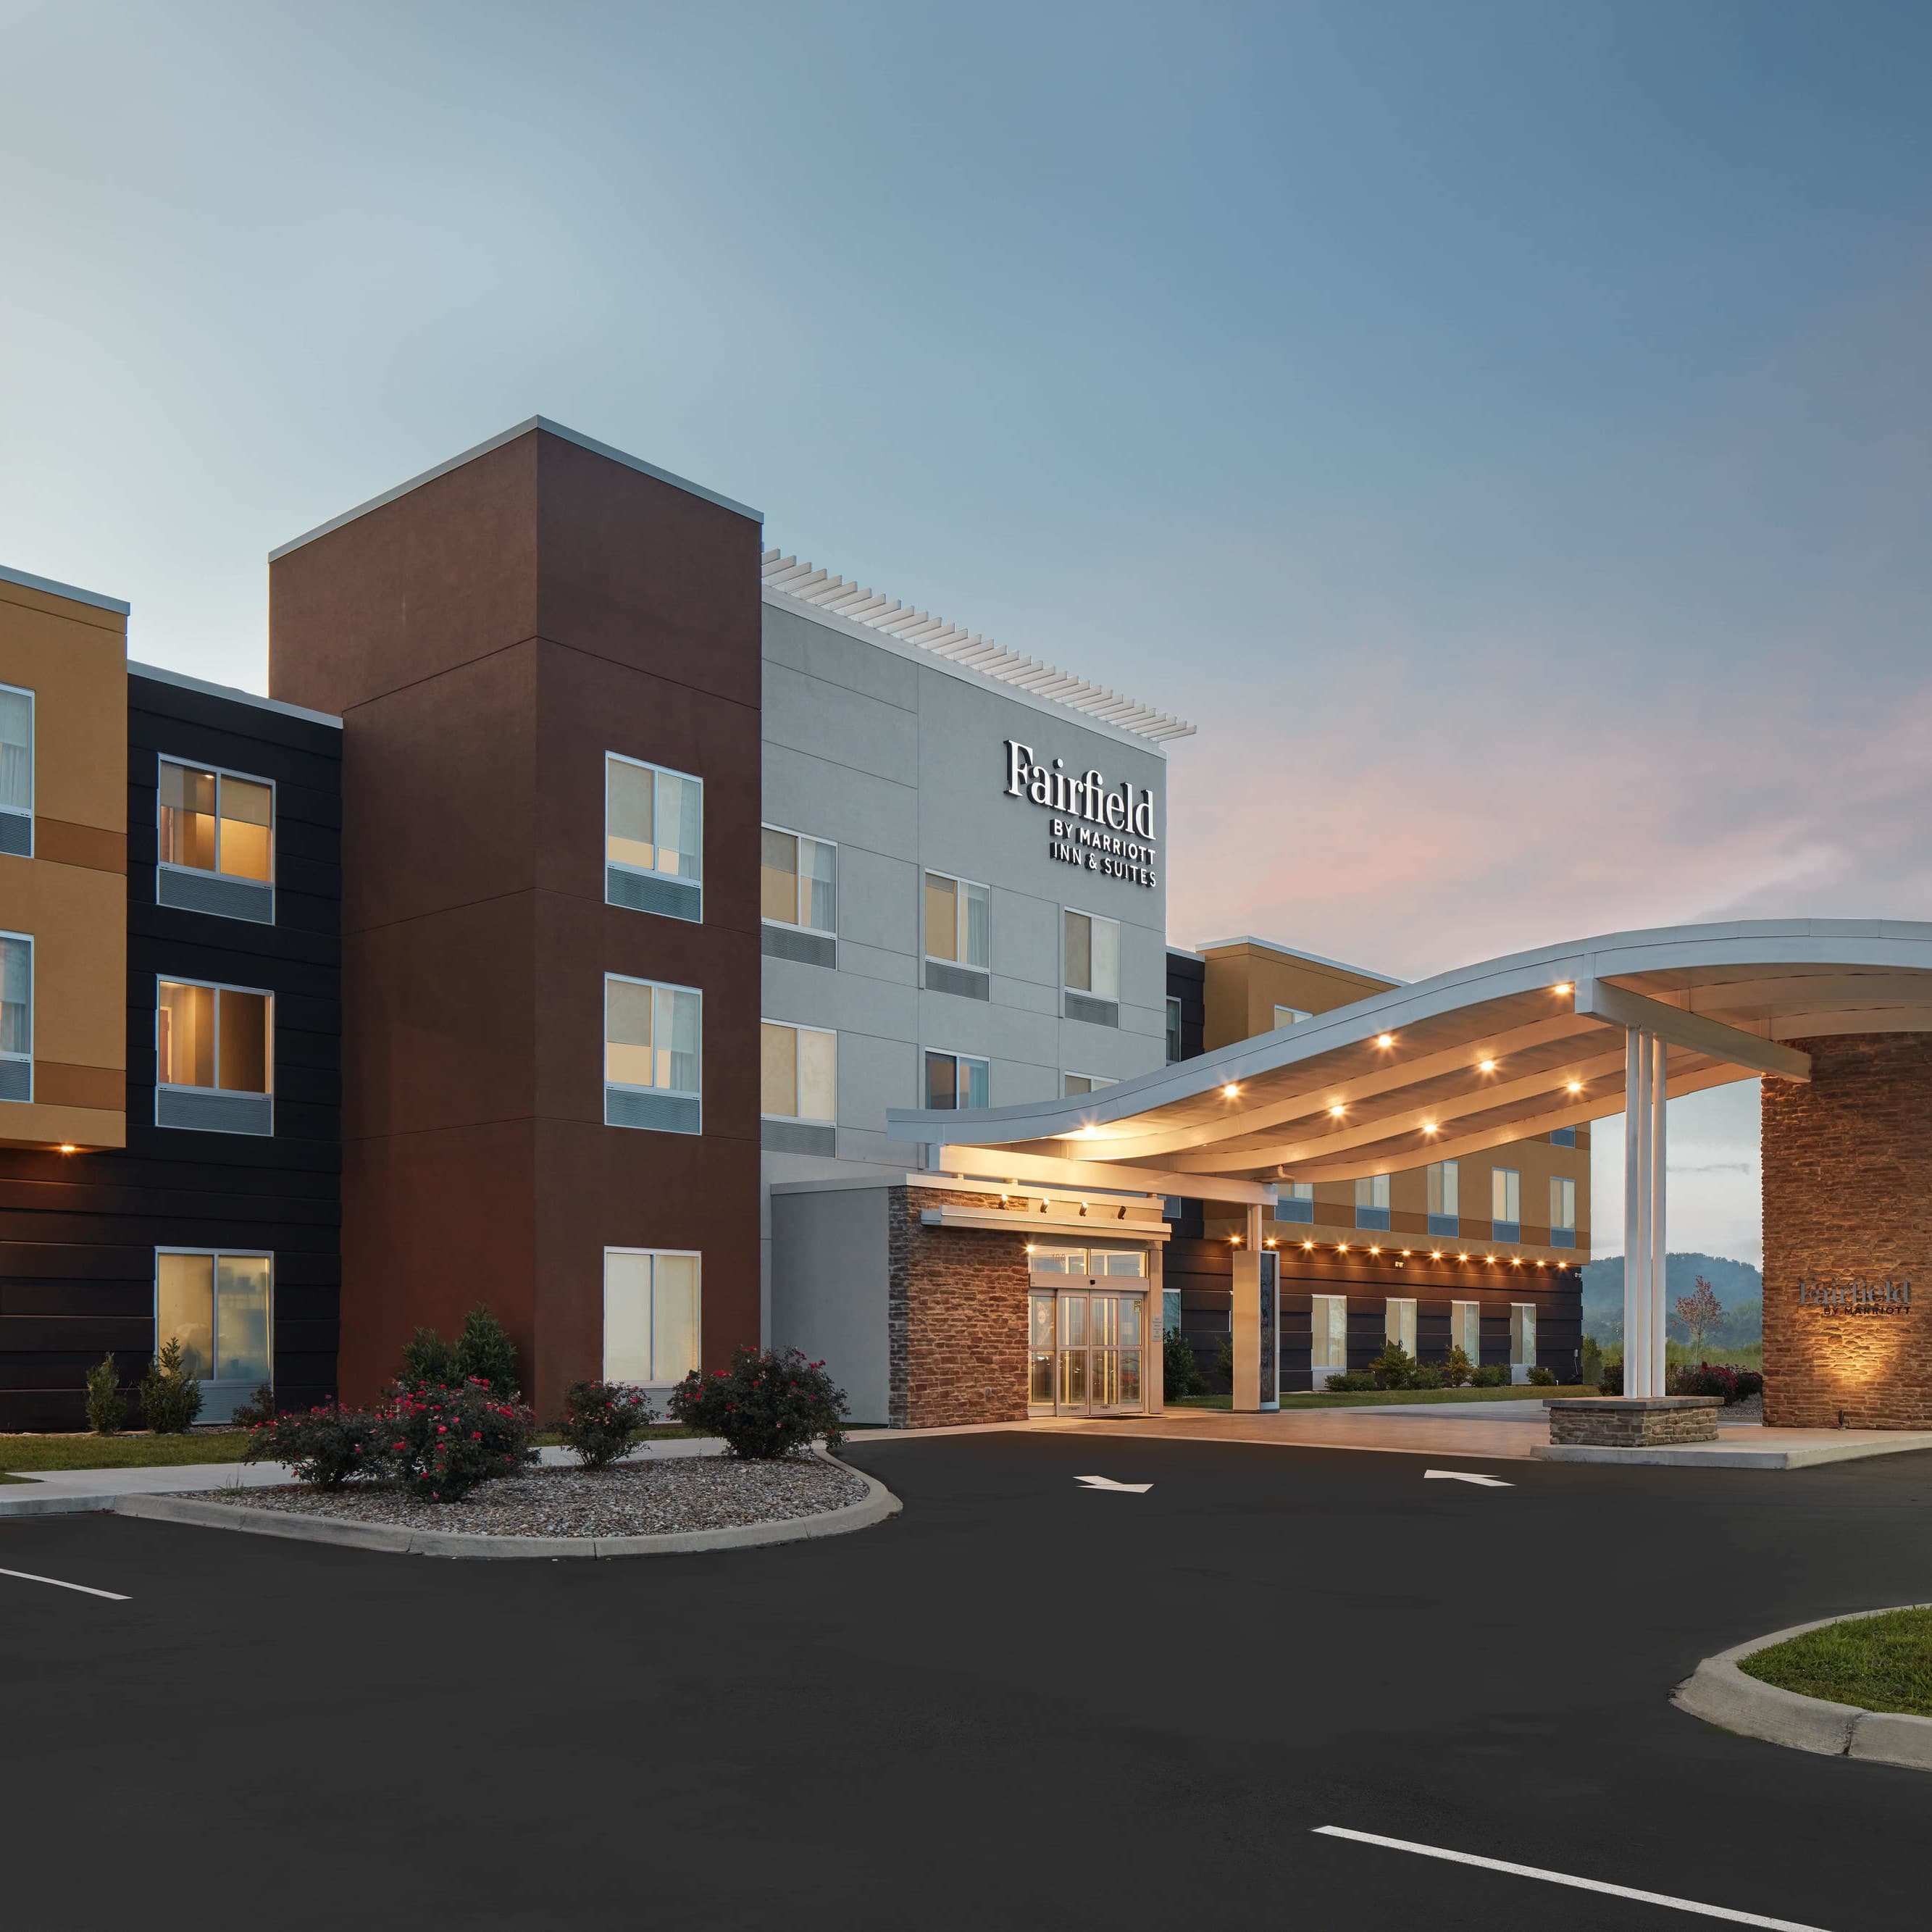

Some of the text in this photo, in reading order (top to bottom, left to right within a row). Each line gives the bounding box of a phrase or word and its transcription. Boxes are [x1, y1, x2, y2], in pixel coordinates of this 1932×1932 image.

[1003, 740, 1156, 840] Fairfield
[1050, 819, 1156, 865] BY MARRIOTT
[1050, 842, 1157, 887] INN & SUITES
[1799, 1279, 1911, 1304] Fairfield
[1824, 1306, 1911, 1316] BY MARRIOTT
